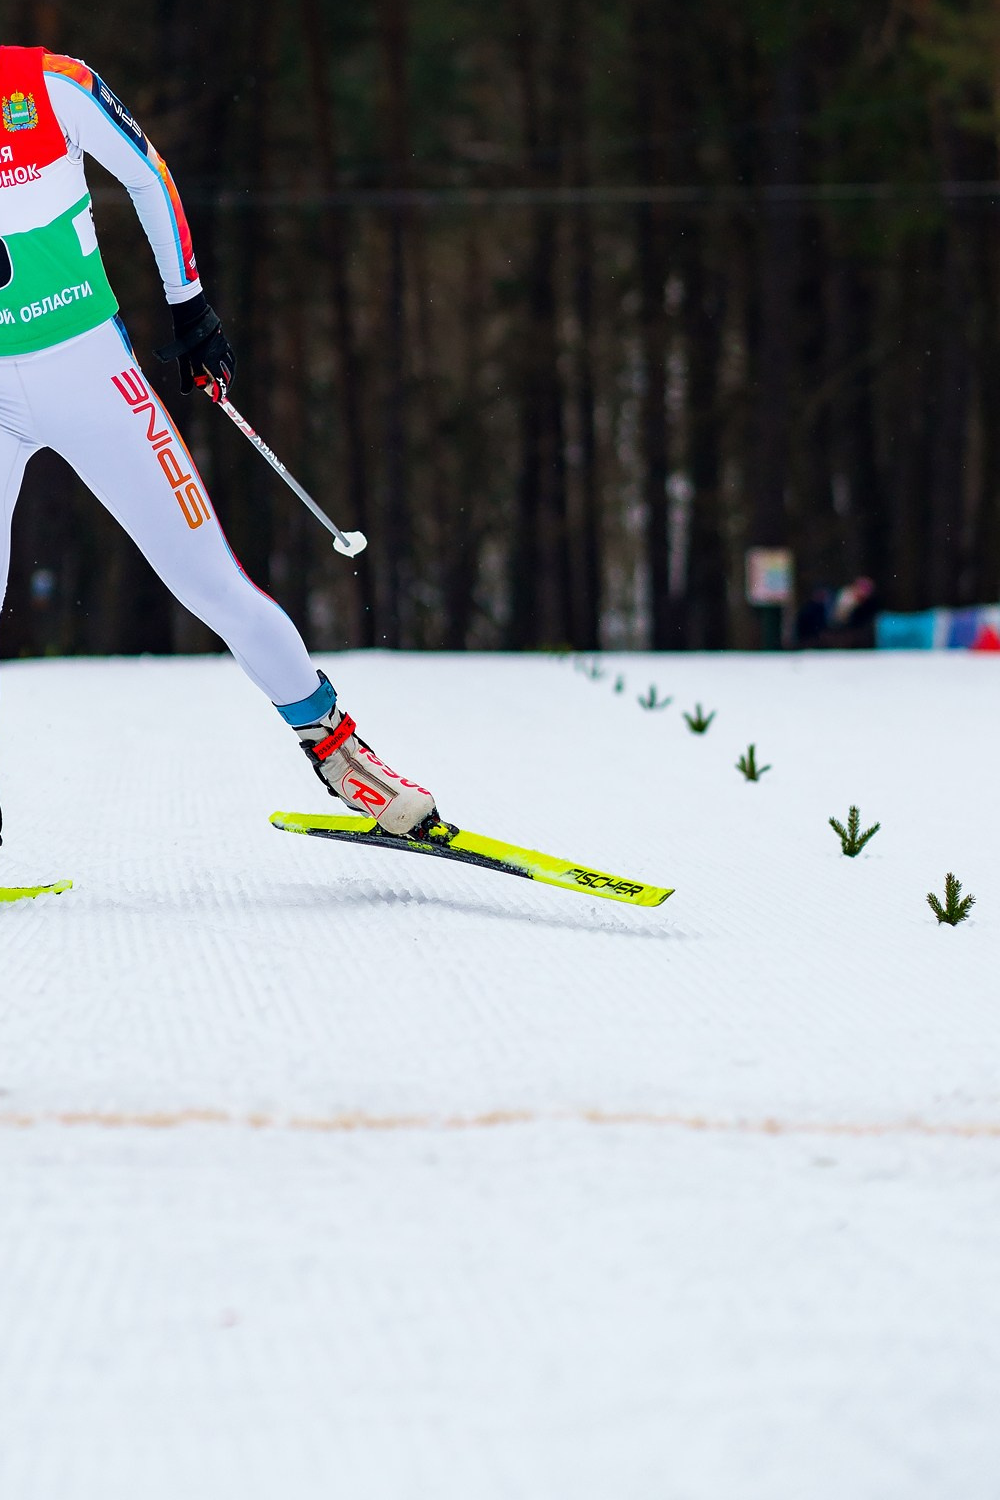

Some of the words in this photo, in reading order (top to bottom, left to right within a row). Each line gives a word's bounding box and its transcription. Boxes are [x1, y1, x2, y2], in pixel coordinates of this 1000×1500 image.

[100, 85, 142, 138] SPINE
[19, 280, 94, 323] ОБЛАСТИ
[110, 367, 211, 530] SPINE
[566, 868, 645, 897] FISCHER
